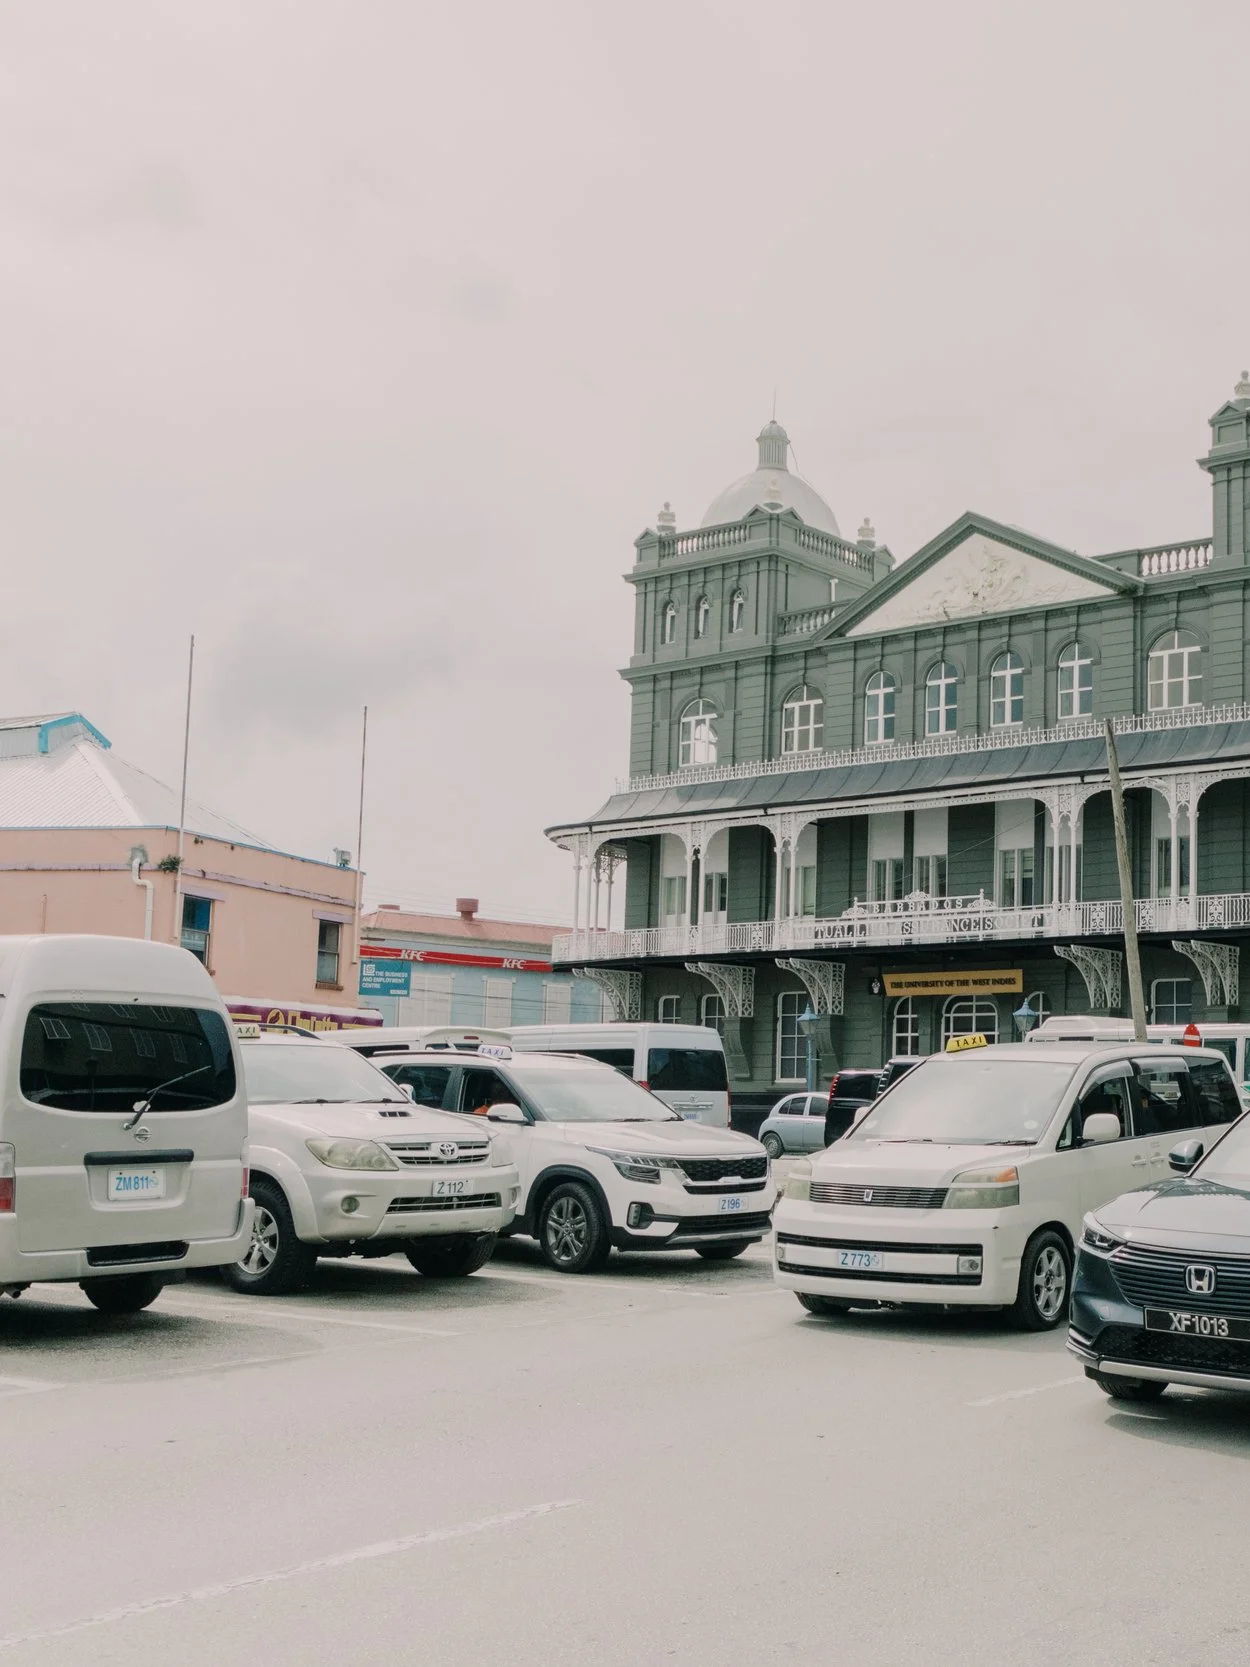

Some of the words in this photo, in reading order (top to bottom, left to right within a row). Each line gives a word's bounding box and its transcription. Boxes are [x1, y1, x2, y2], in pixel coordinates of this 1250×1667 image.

[873, 899, 963, 914] BARBADOS
[400, 949, 426, 962] KFC
[502, 958, 527, 970] KFC
[890, 981, 904, 989] THE
[904, 980, 944, 989] UNIVERSITY
[945, 979, 954, 988] OF
[956, 979, 970, 987] THE
[972, 978, 991, 986] WEST
[992, 977, 1017, 986] INDIES
[234, 1026, 257, 1035] AXI
[956, 1036, 983, 1048] TAXI
[481, 1047, 504, 1056] TAXI
[1168, 1312, 1229, 1337] XF1013
